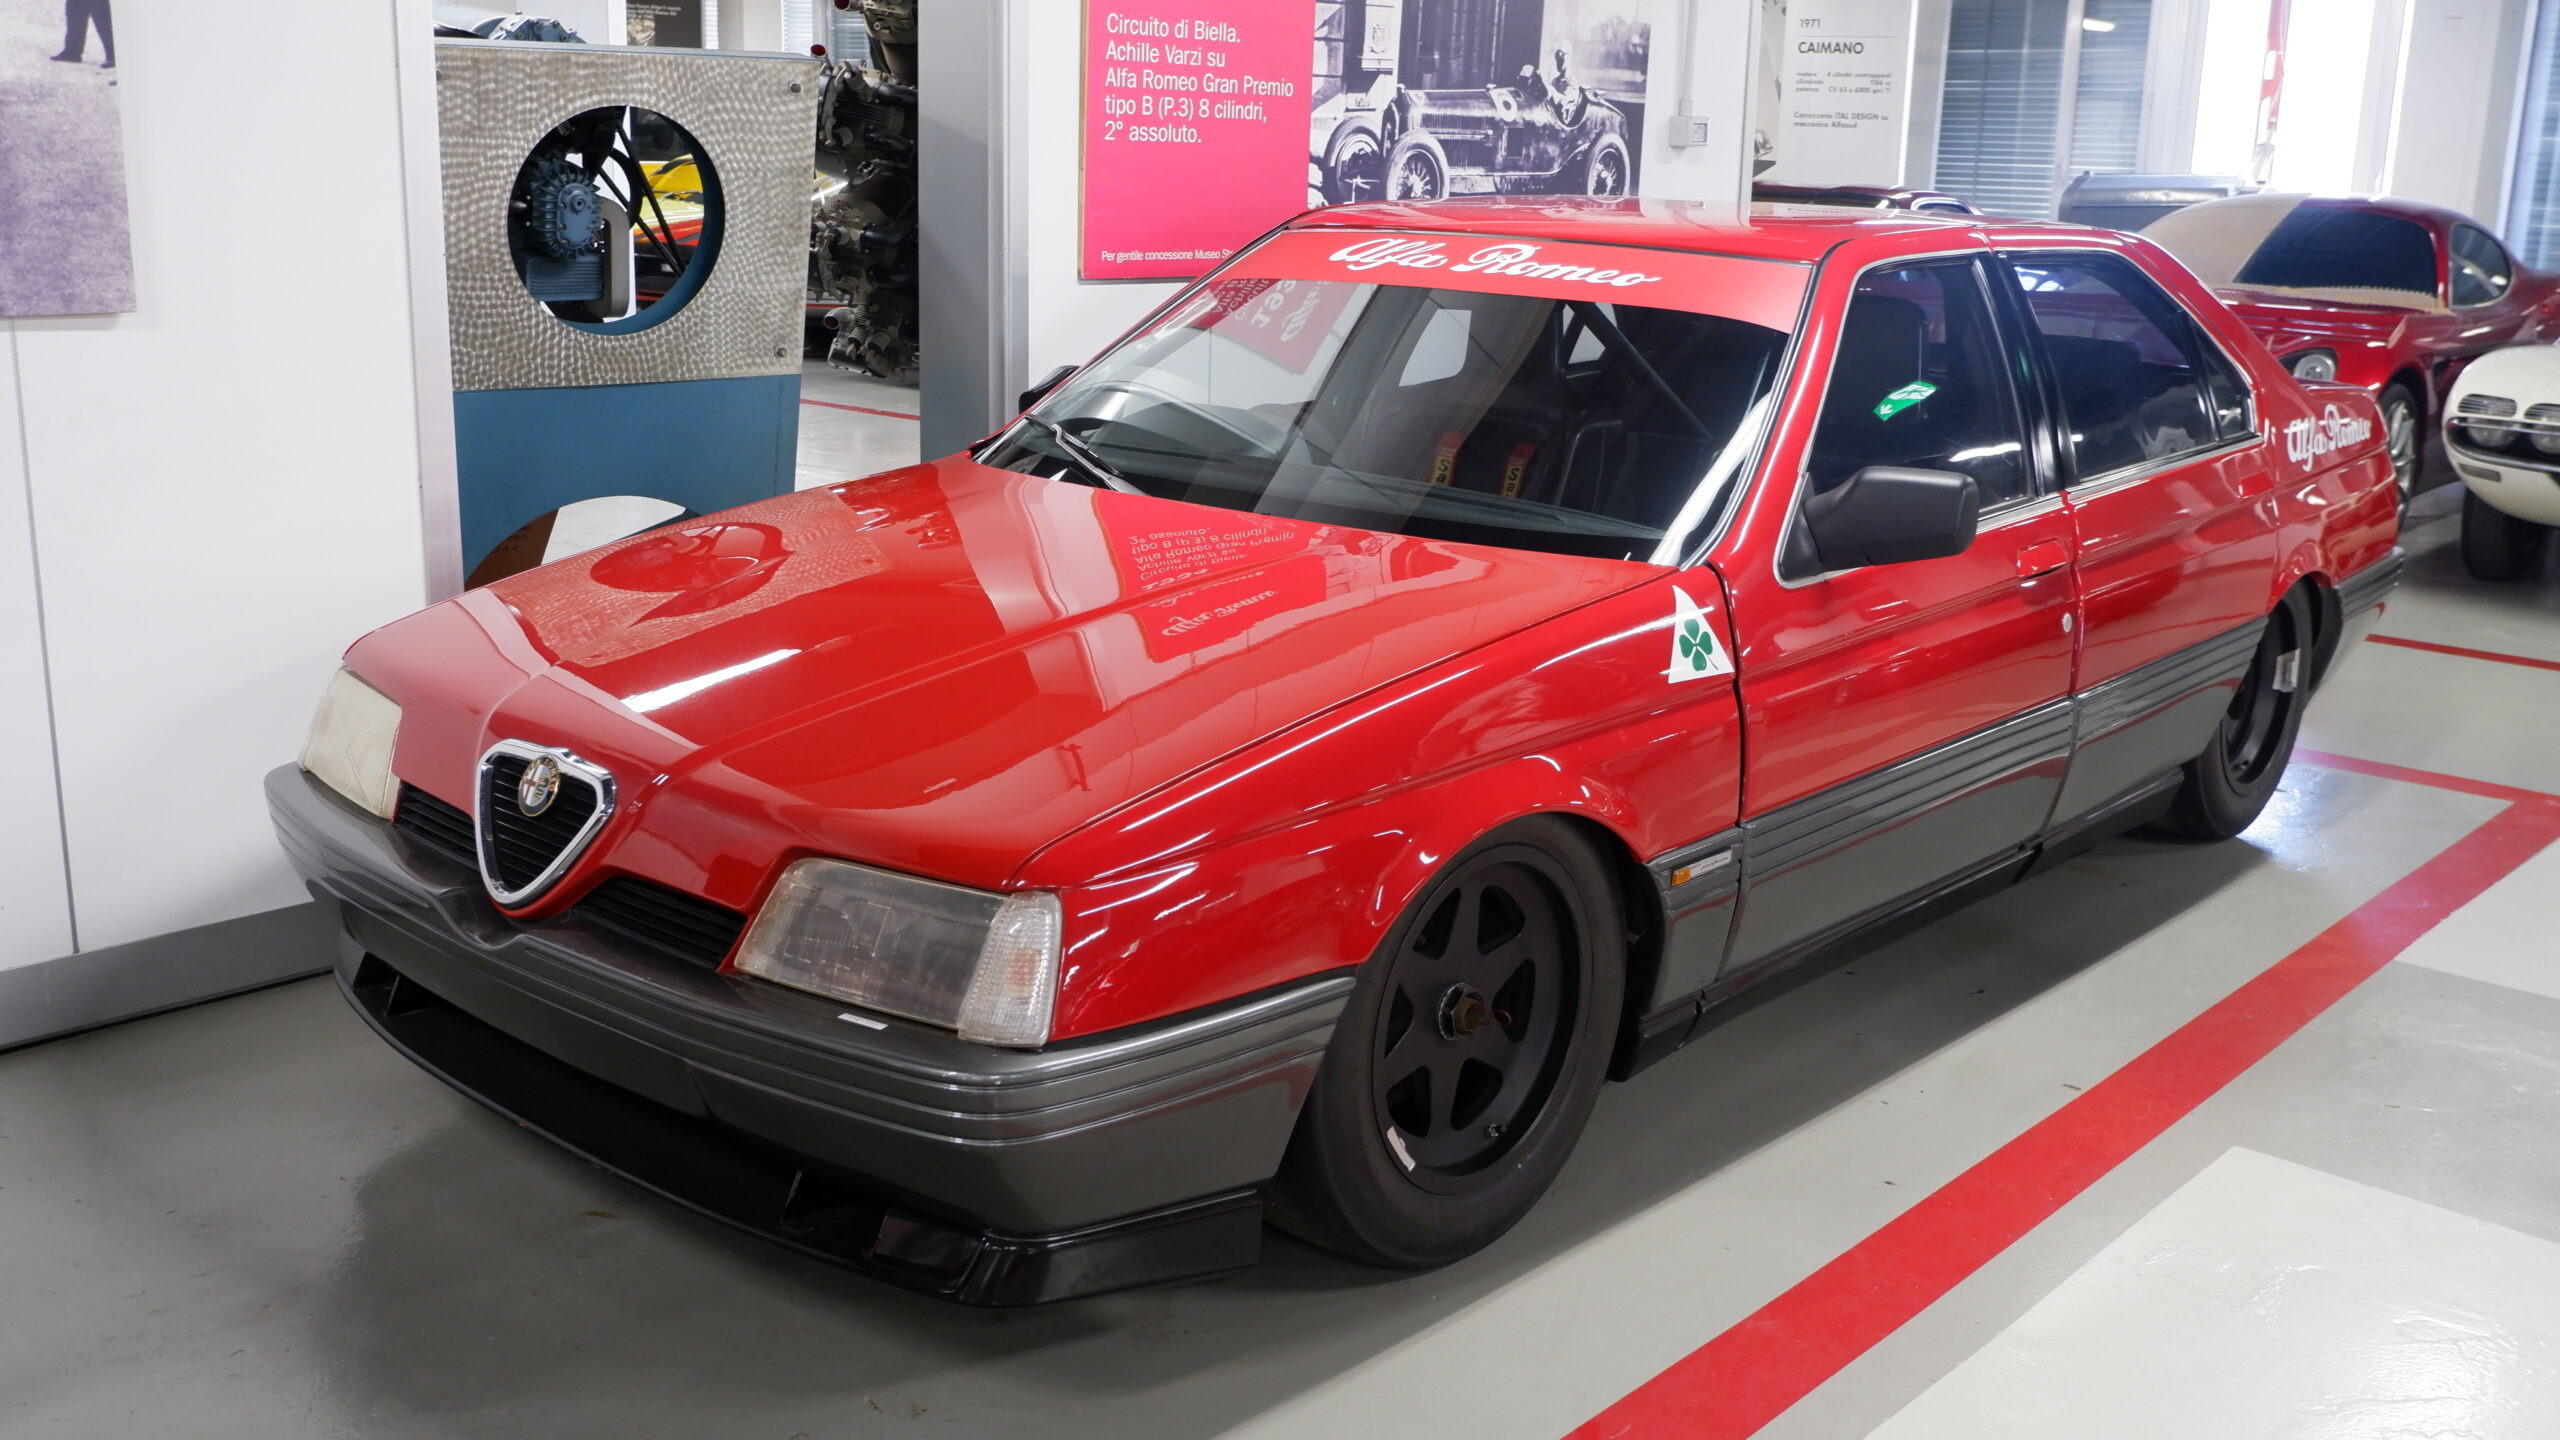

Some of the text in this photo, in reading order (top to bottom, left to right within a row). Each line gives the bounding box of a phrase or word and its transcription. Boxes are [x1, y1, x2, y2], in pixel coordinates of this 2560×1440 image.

[1106, 12, 1241, 43] Circuito di Biella.
[1799, 18, 1821, 29] 1971
[1105, 40, 1226, 68] Achille Varzi su
[1798, 41, 1865, 54] CAIMANO
[1105, 67, 1294, 97] Alfa Romeo Gran Premio
[1104, 94, 1267, 123] tipo B (P.3) 8 cilindri,
[1851, 112, 1879, 120] DESIGN
[1128, 123, 1202, 143] assoluto.
[1101, 250, 1115, 262] Per
[1116, 250, 1144, 264] gentile
[1145, 250, 1194, 261] concessione
[1194, 249, 1220, 260] Museo
[1328, 237, 1662, 287] Alfa Romeo
[2283, 416, 2328, 472] Alfa
